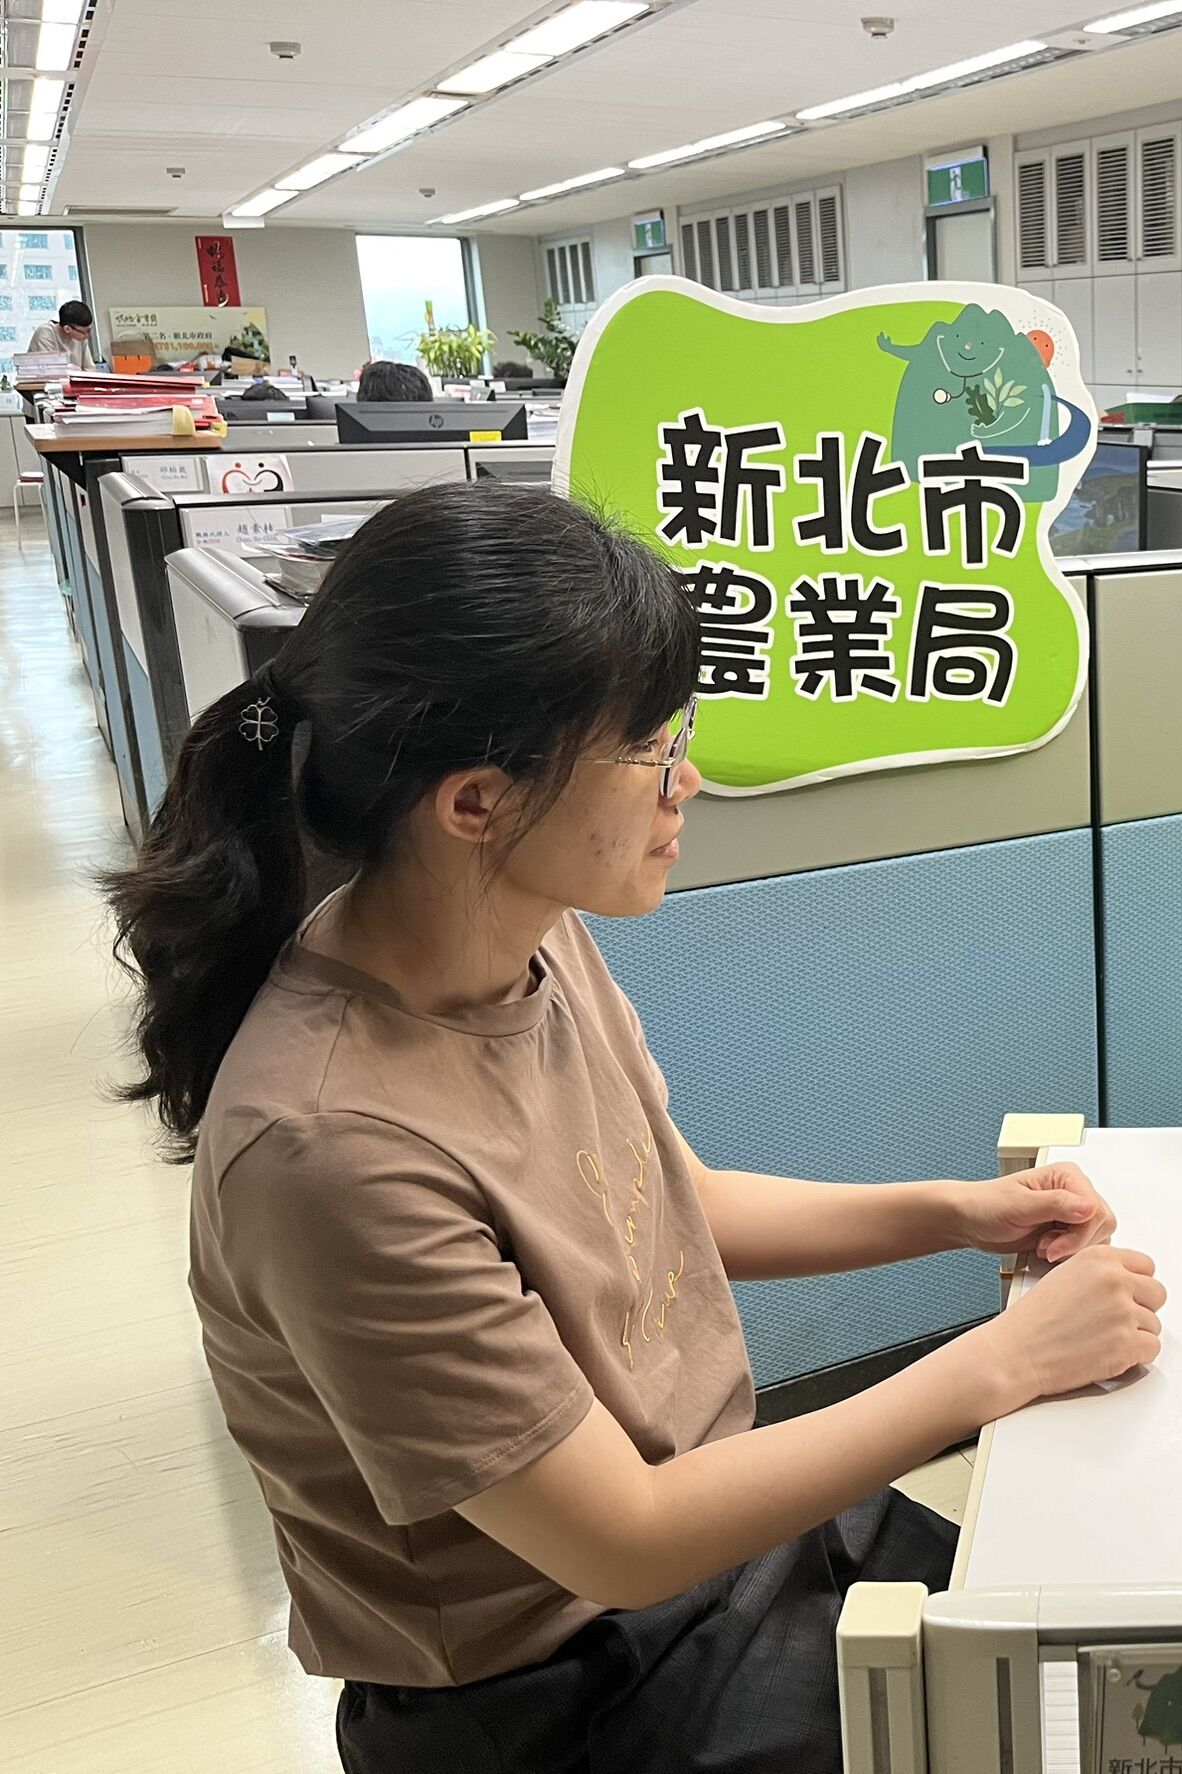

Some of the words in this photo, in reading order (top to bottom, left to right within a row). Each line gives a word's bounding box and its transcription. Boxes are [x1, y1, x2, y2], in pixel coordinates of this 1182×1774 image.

[659, 411, 1026, 565] 新北市
[681, 565, 1015, 703] 農業局
